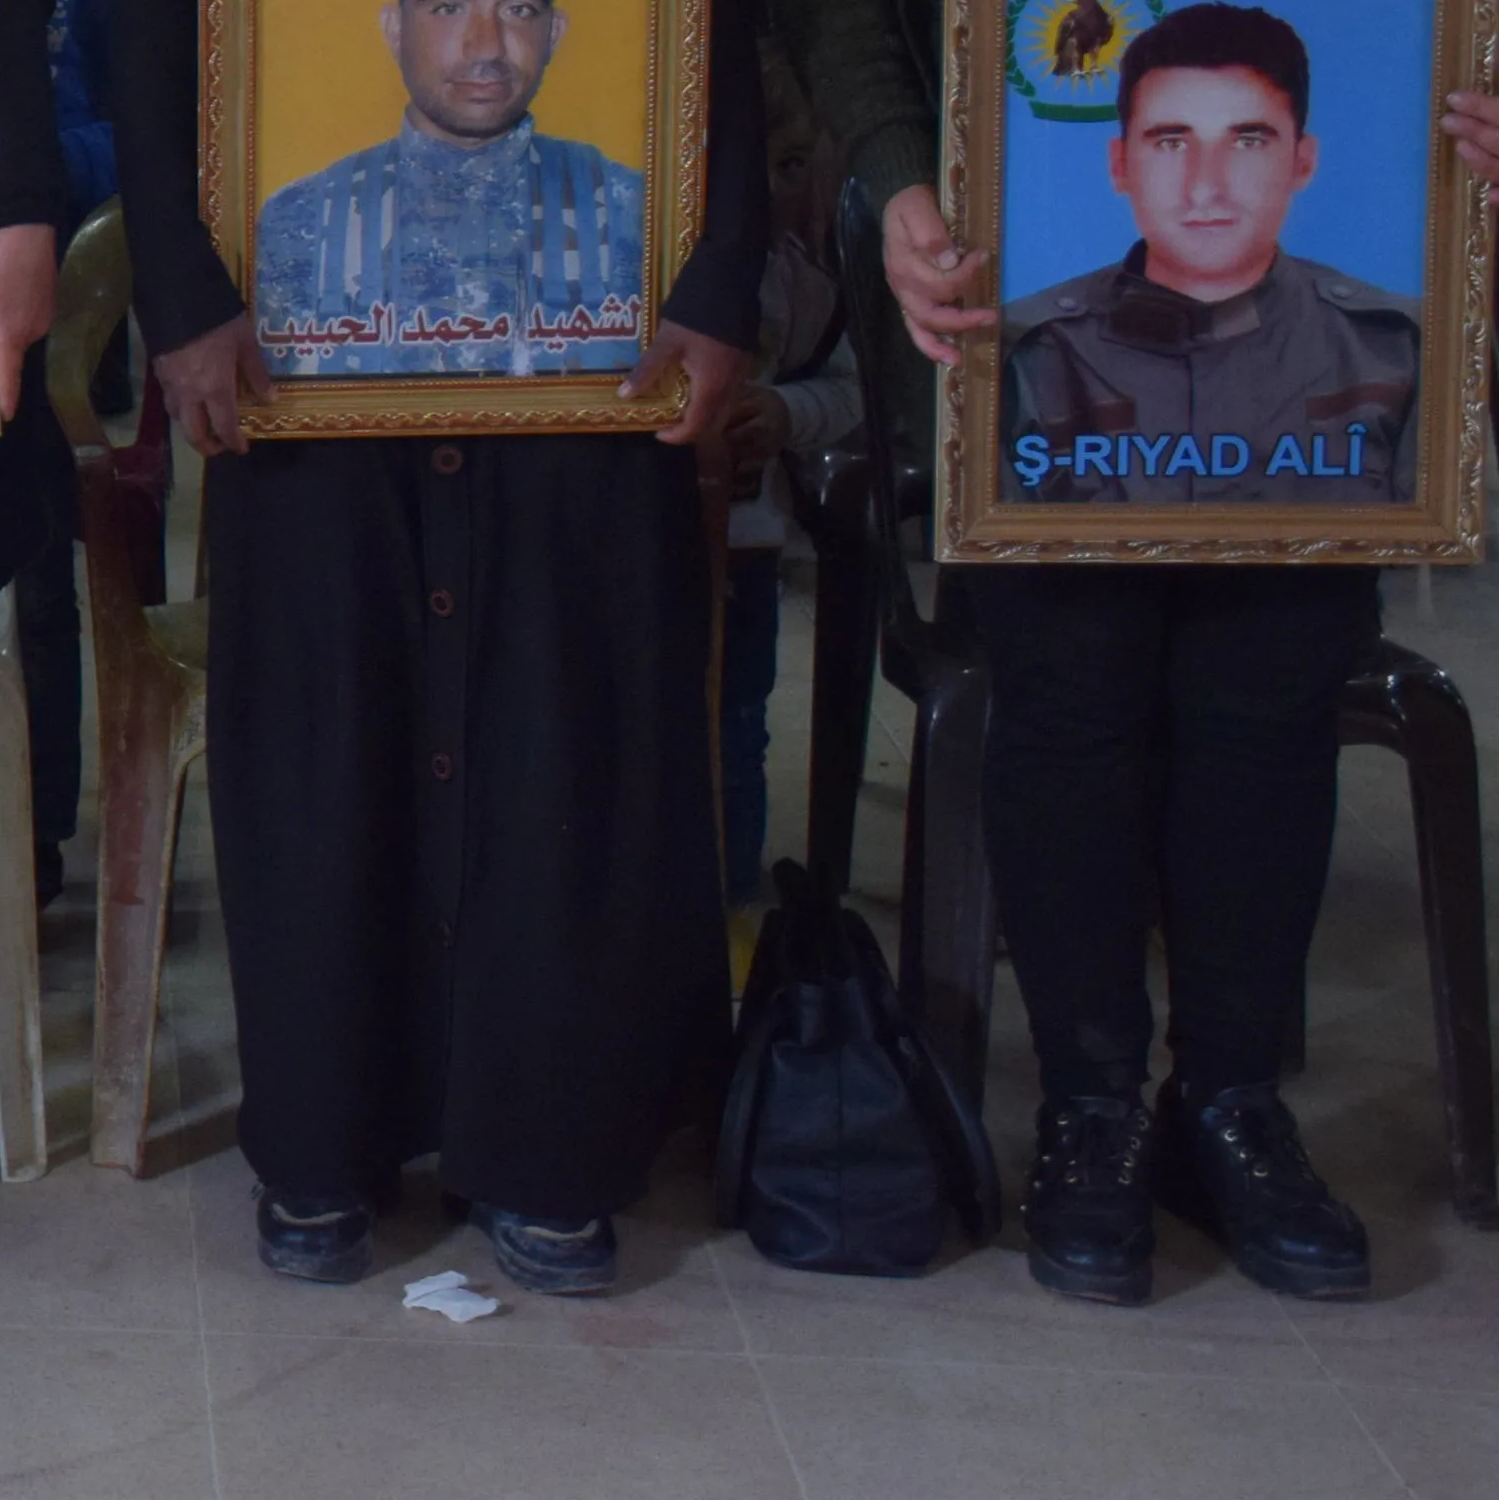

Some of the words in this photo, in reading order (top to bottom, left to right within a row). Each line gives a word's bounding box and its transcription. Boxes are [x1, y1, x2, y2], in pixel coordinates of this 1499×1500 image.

[256, 301, 396, 359] الحبيب
[399, 305, 512, 347] محمد
[1014, 434, 1251, 487] Ş-RIYAD
[1264, 423, 1369, 477] ALÎ
